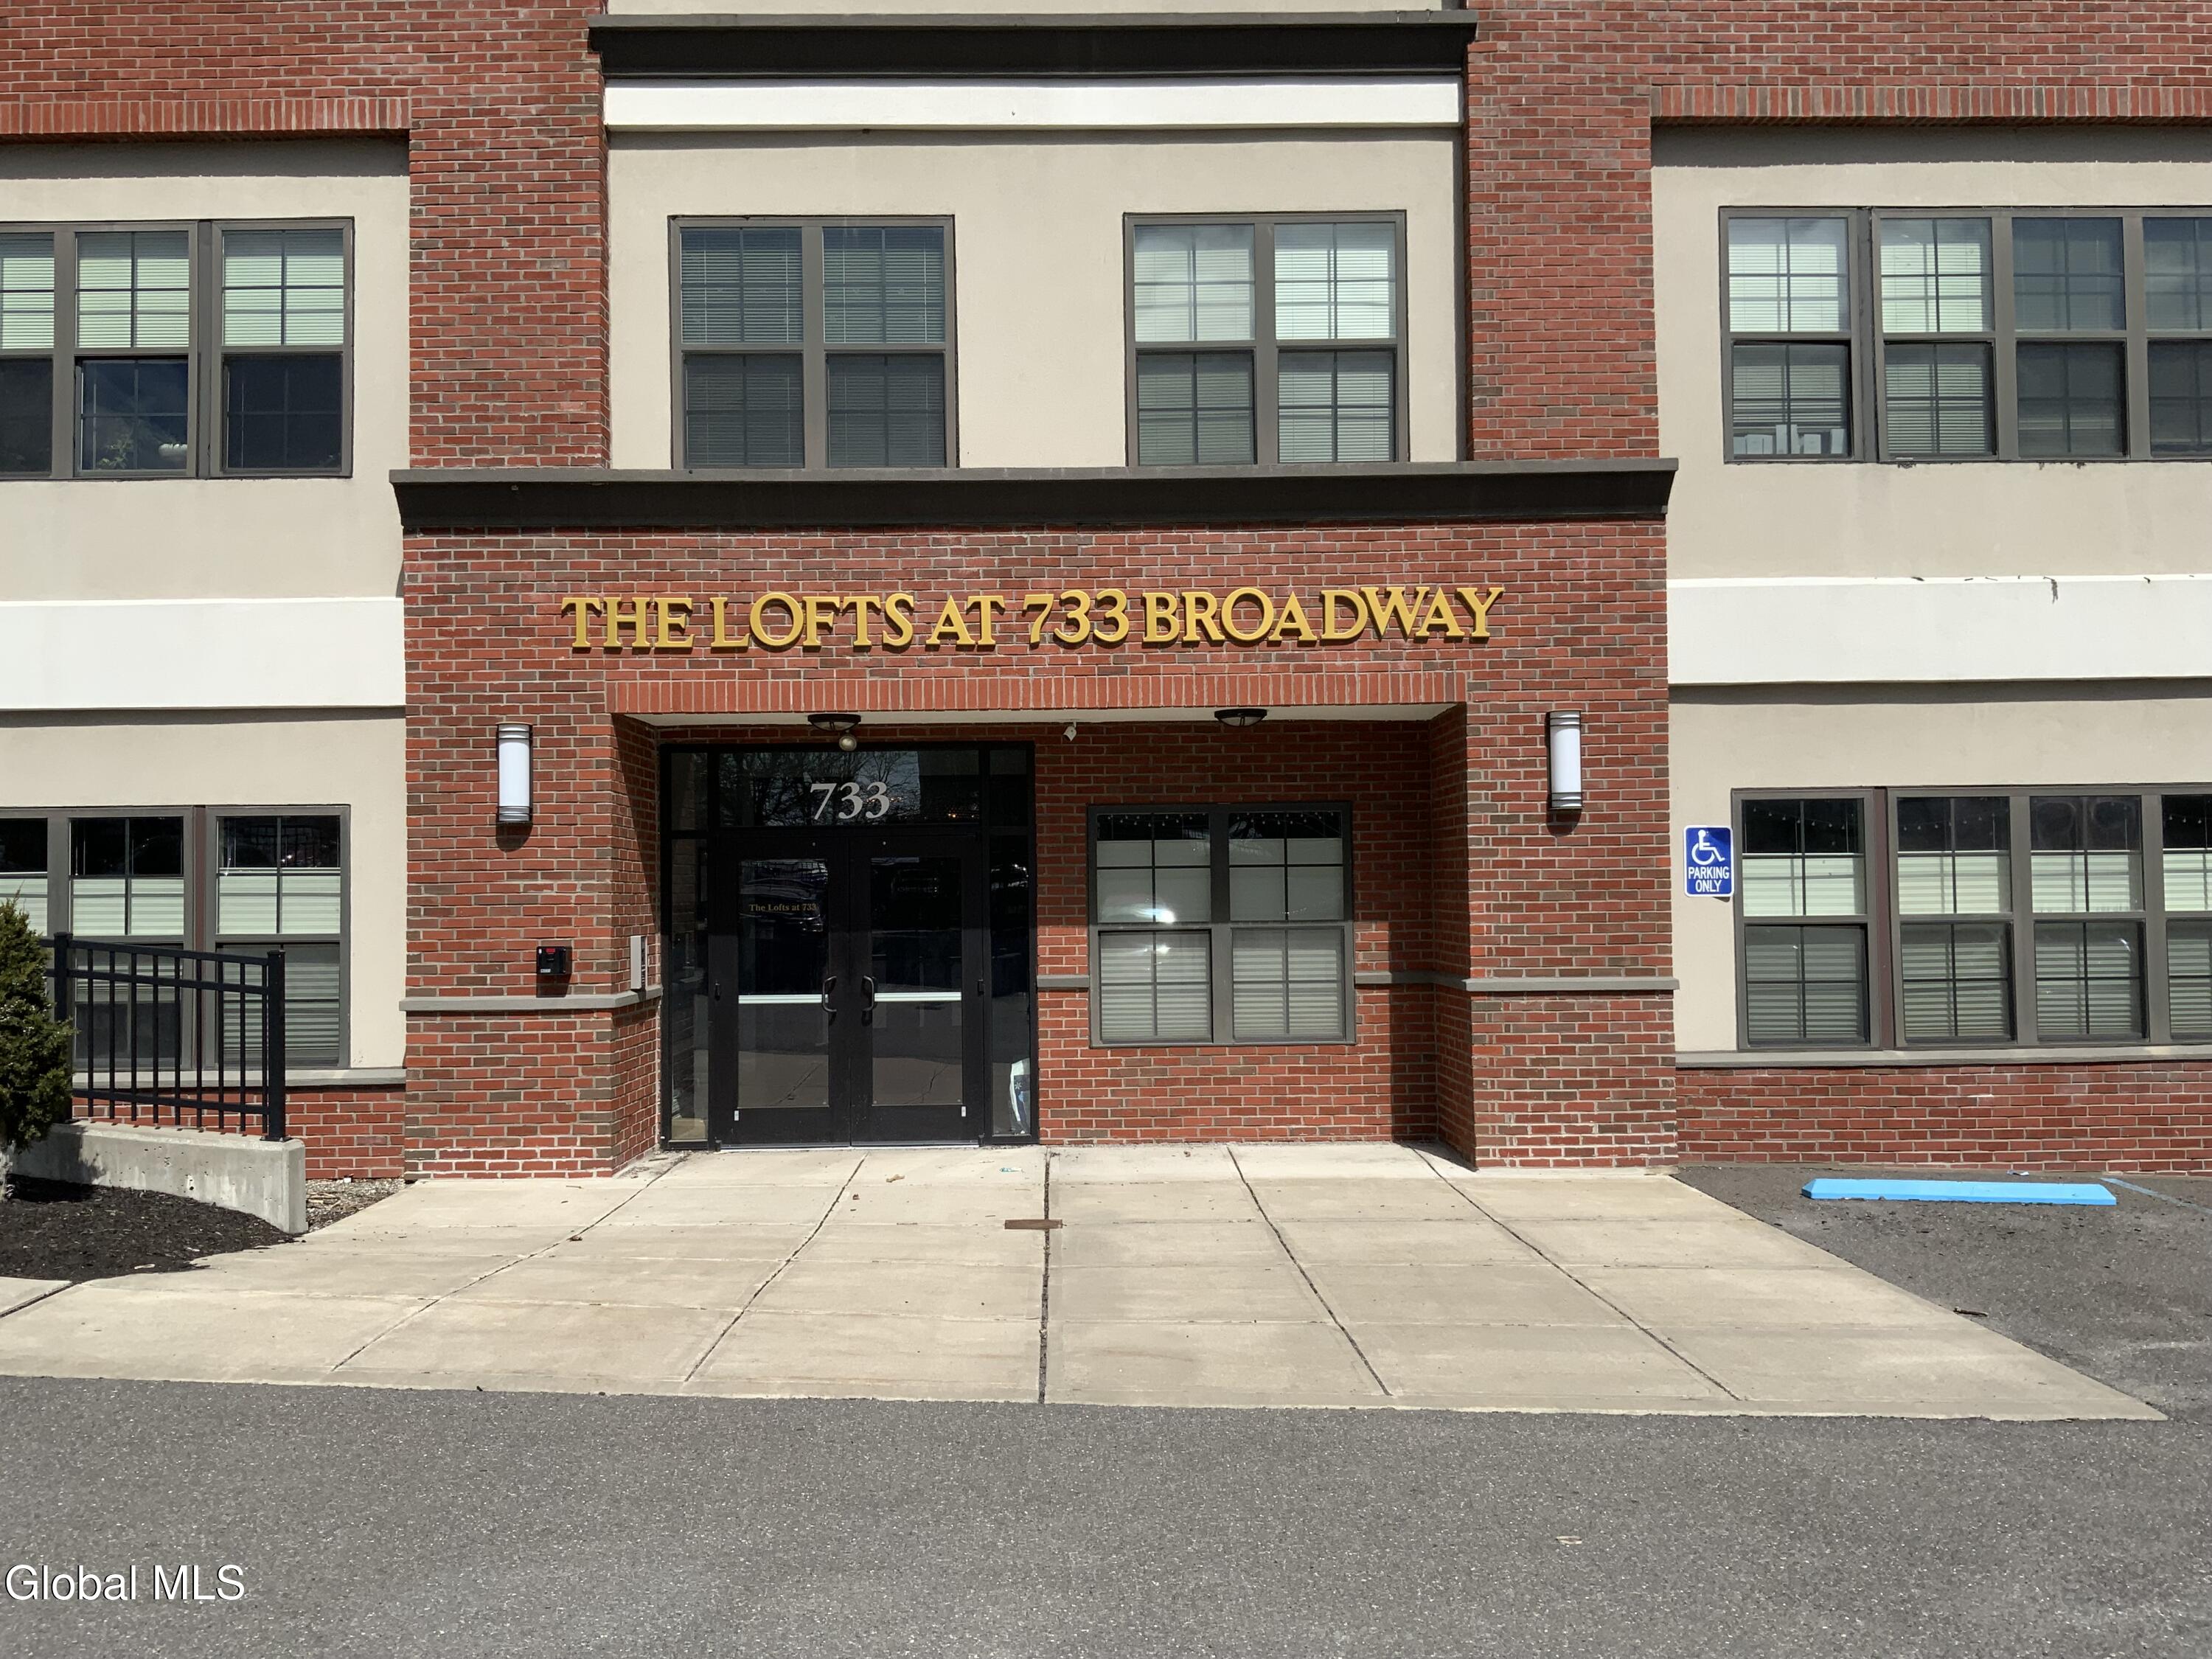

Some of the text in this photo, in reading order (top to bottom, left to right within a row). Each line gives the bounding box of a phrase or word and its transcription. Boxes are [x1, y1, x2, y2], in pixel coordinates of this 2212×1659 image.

[561, 587, 1506, 650] THE LOFTS AT 733 BROADWAY
[810, 781, 891, 821] 733
[1688, 866, 1730, 880] PARKING
[1695, 880, 1722, 892] ONLY
[802, 903, 817, 911] 733
